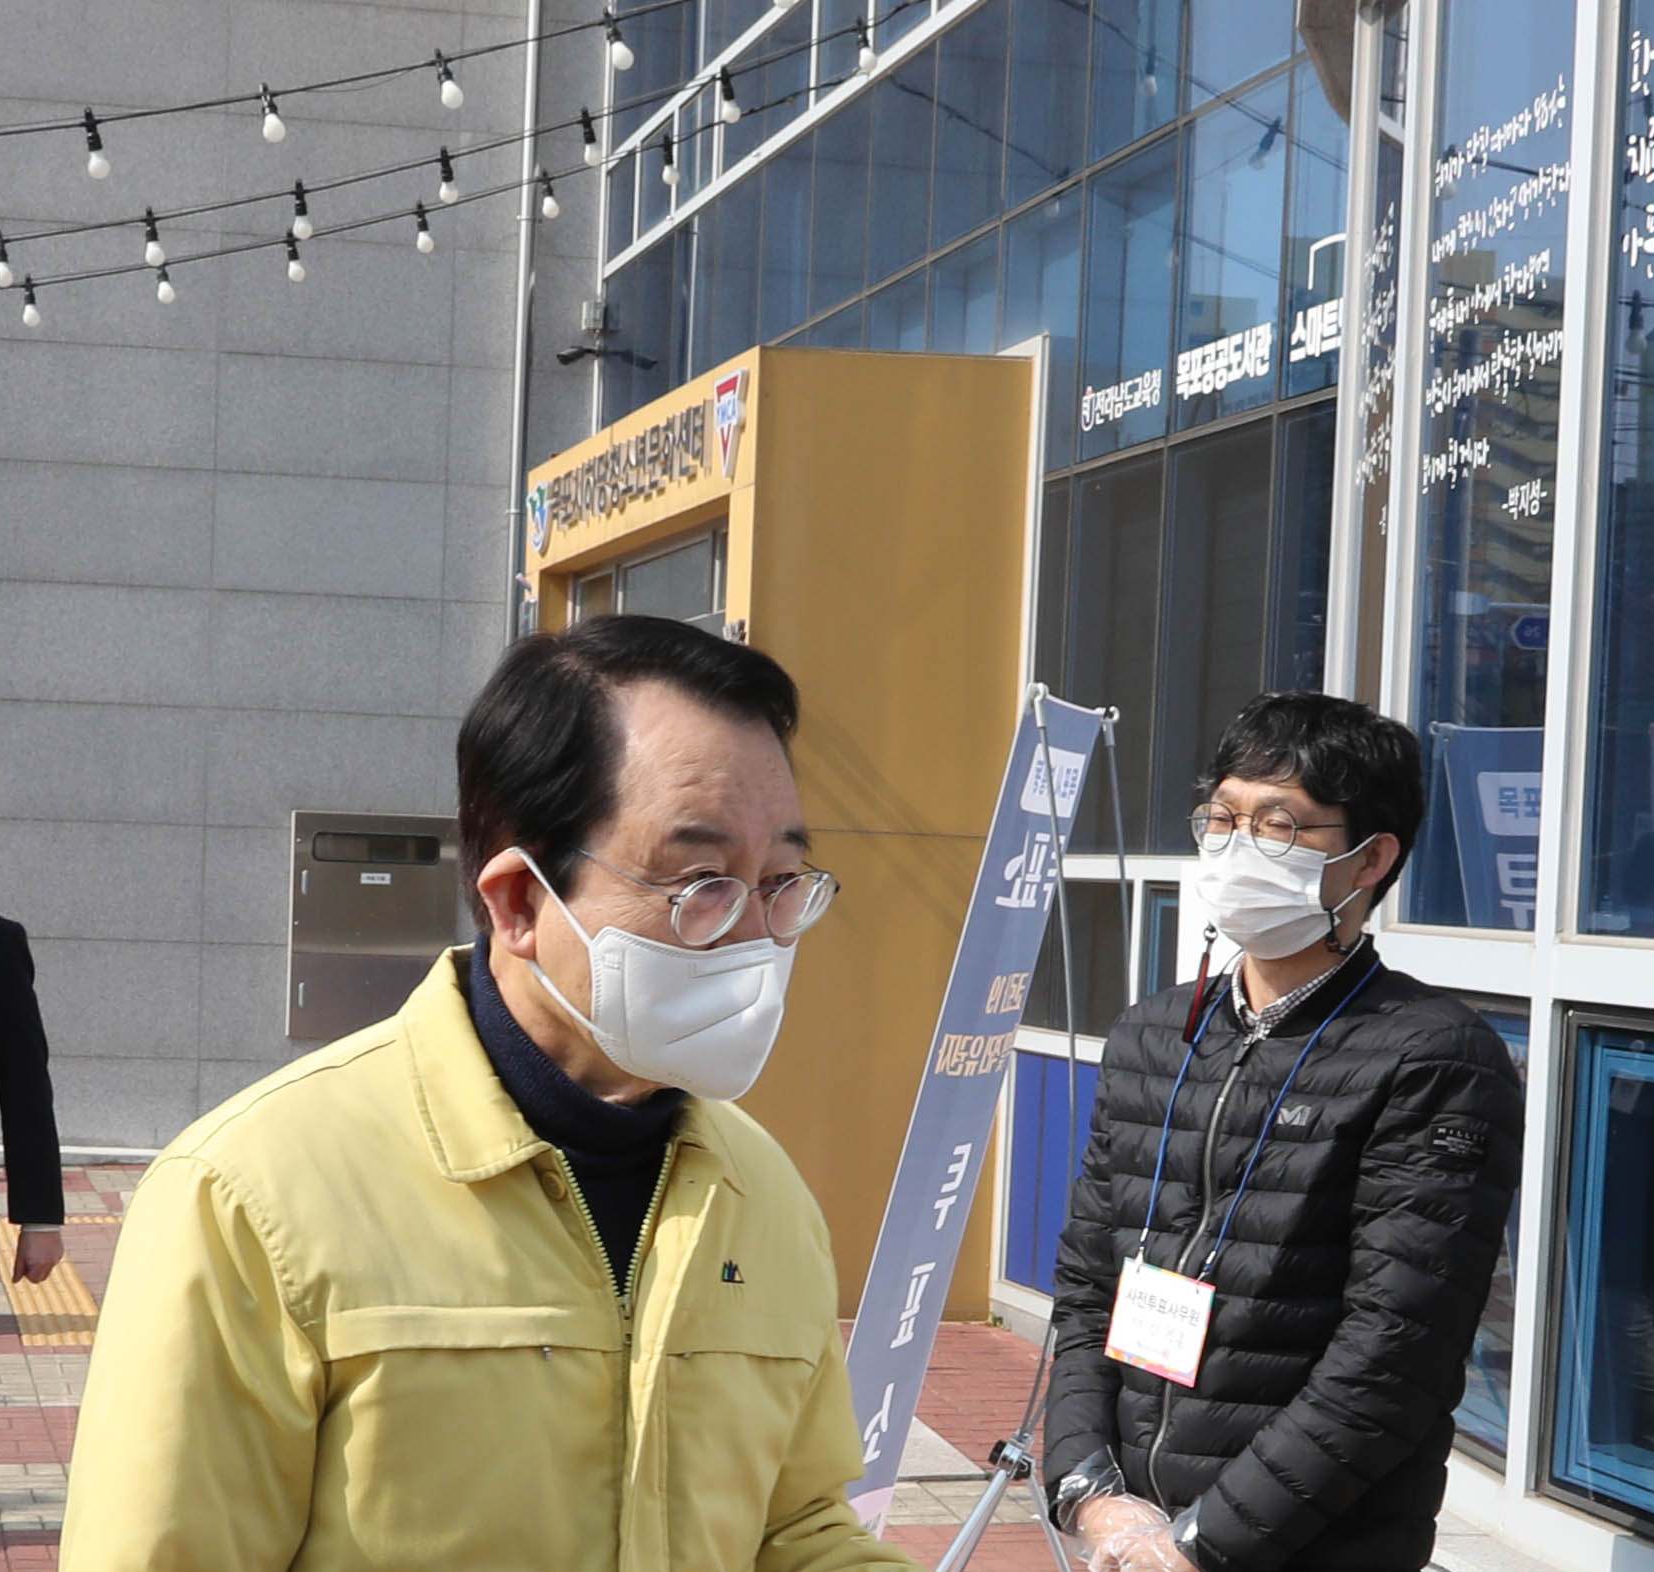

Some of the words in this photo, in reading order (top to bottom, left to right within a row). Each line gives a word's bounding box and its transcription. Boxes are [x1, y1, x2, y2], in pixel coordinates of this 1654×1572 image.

[1095, 369, 1162, 425] 전라남도교육청
[1176, 322, 1272, 400] 목포공공도서관
[1290, 296, 1344, 363] 스마트
[717, 399, 739, 428] YMCA
[1501, 478, 1547, 521] -박지성-
